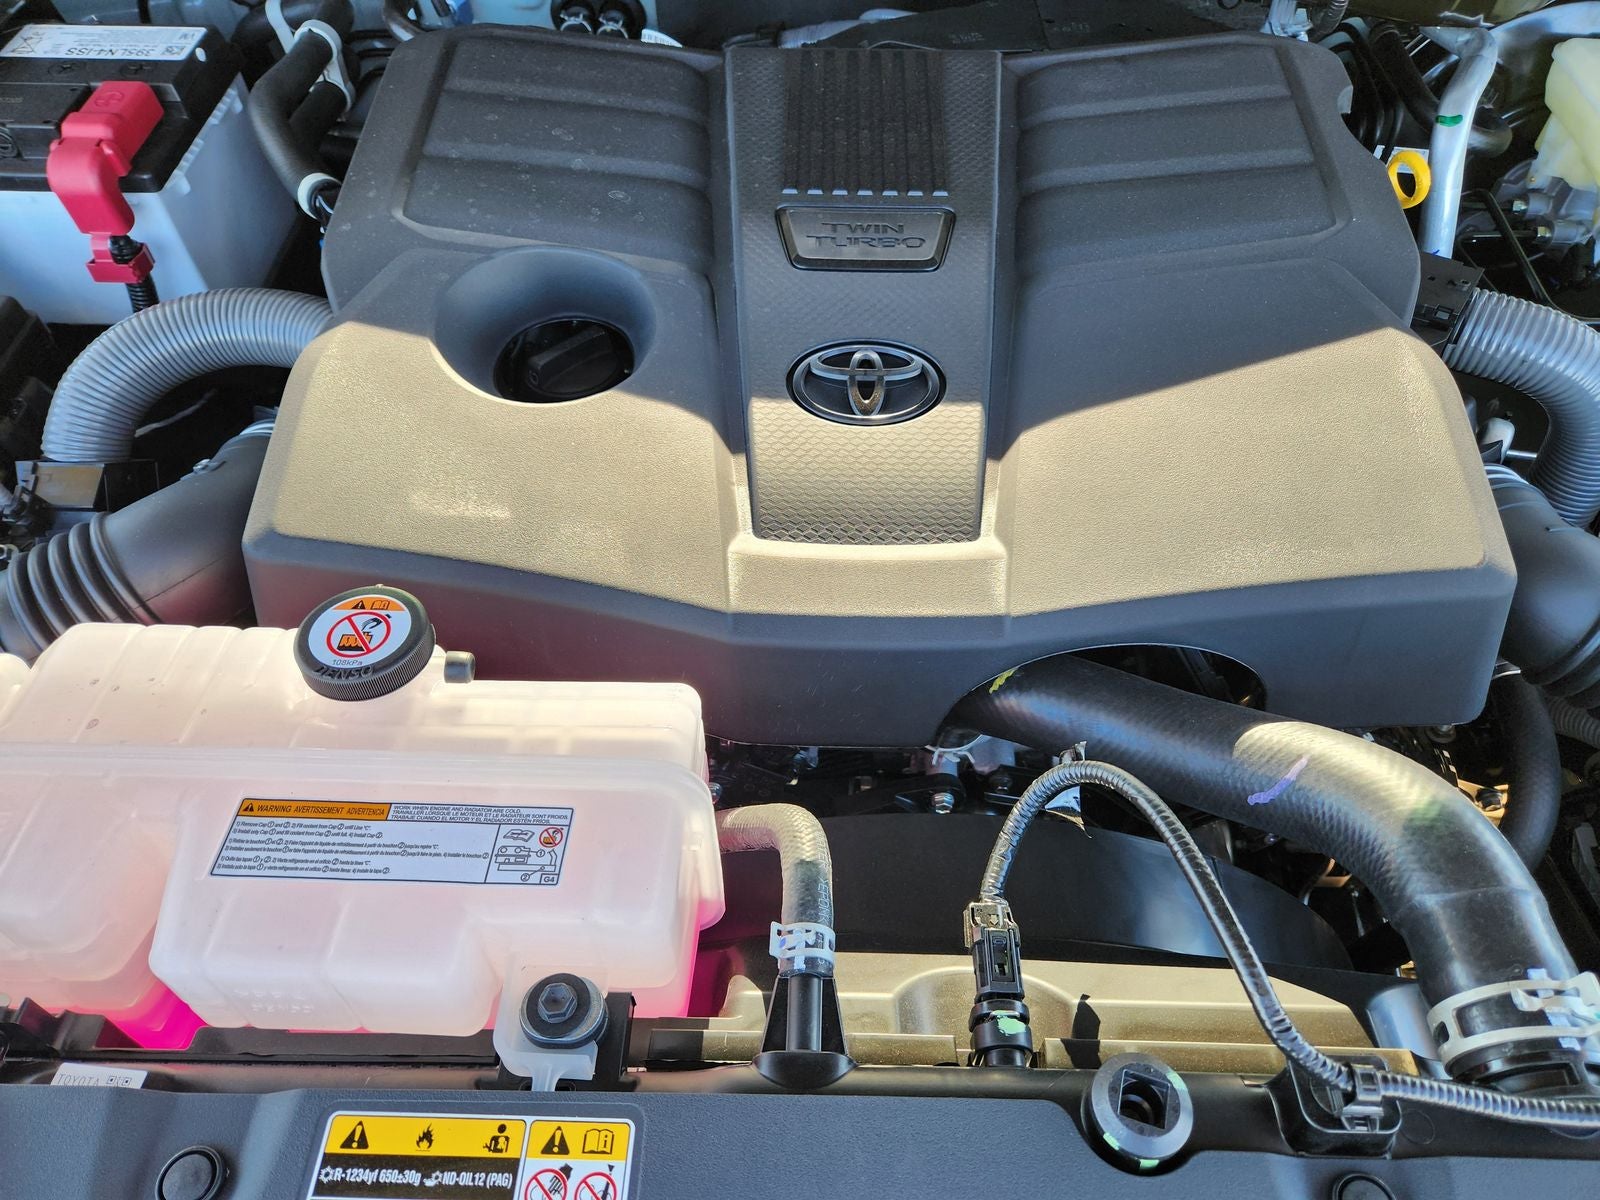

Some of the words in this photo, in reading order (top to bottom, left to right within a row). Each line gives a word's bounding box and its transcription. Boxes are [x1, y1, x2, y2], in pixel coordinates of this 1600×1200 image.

[821, 222, 904, 234] TWIN
[806, 235, 926, 248] TURBO
[314, 666, 373, 679] DENSO
[257, 804, 291, 812] WARNING
[294, 806, 344, 814] AVERTISSEMENT
[346, 807, 384, 816] ADVERTENCIA
[57, 1074, 100, 1086] TOYOTA
[334, 1167, 378, 1185] R-1234yf
[379, 1169, 421, 1187] 650±30g
[442, 1171, 486, 1187] ND-OIL12
[486, 1172, 512, 1189] (PAG)
